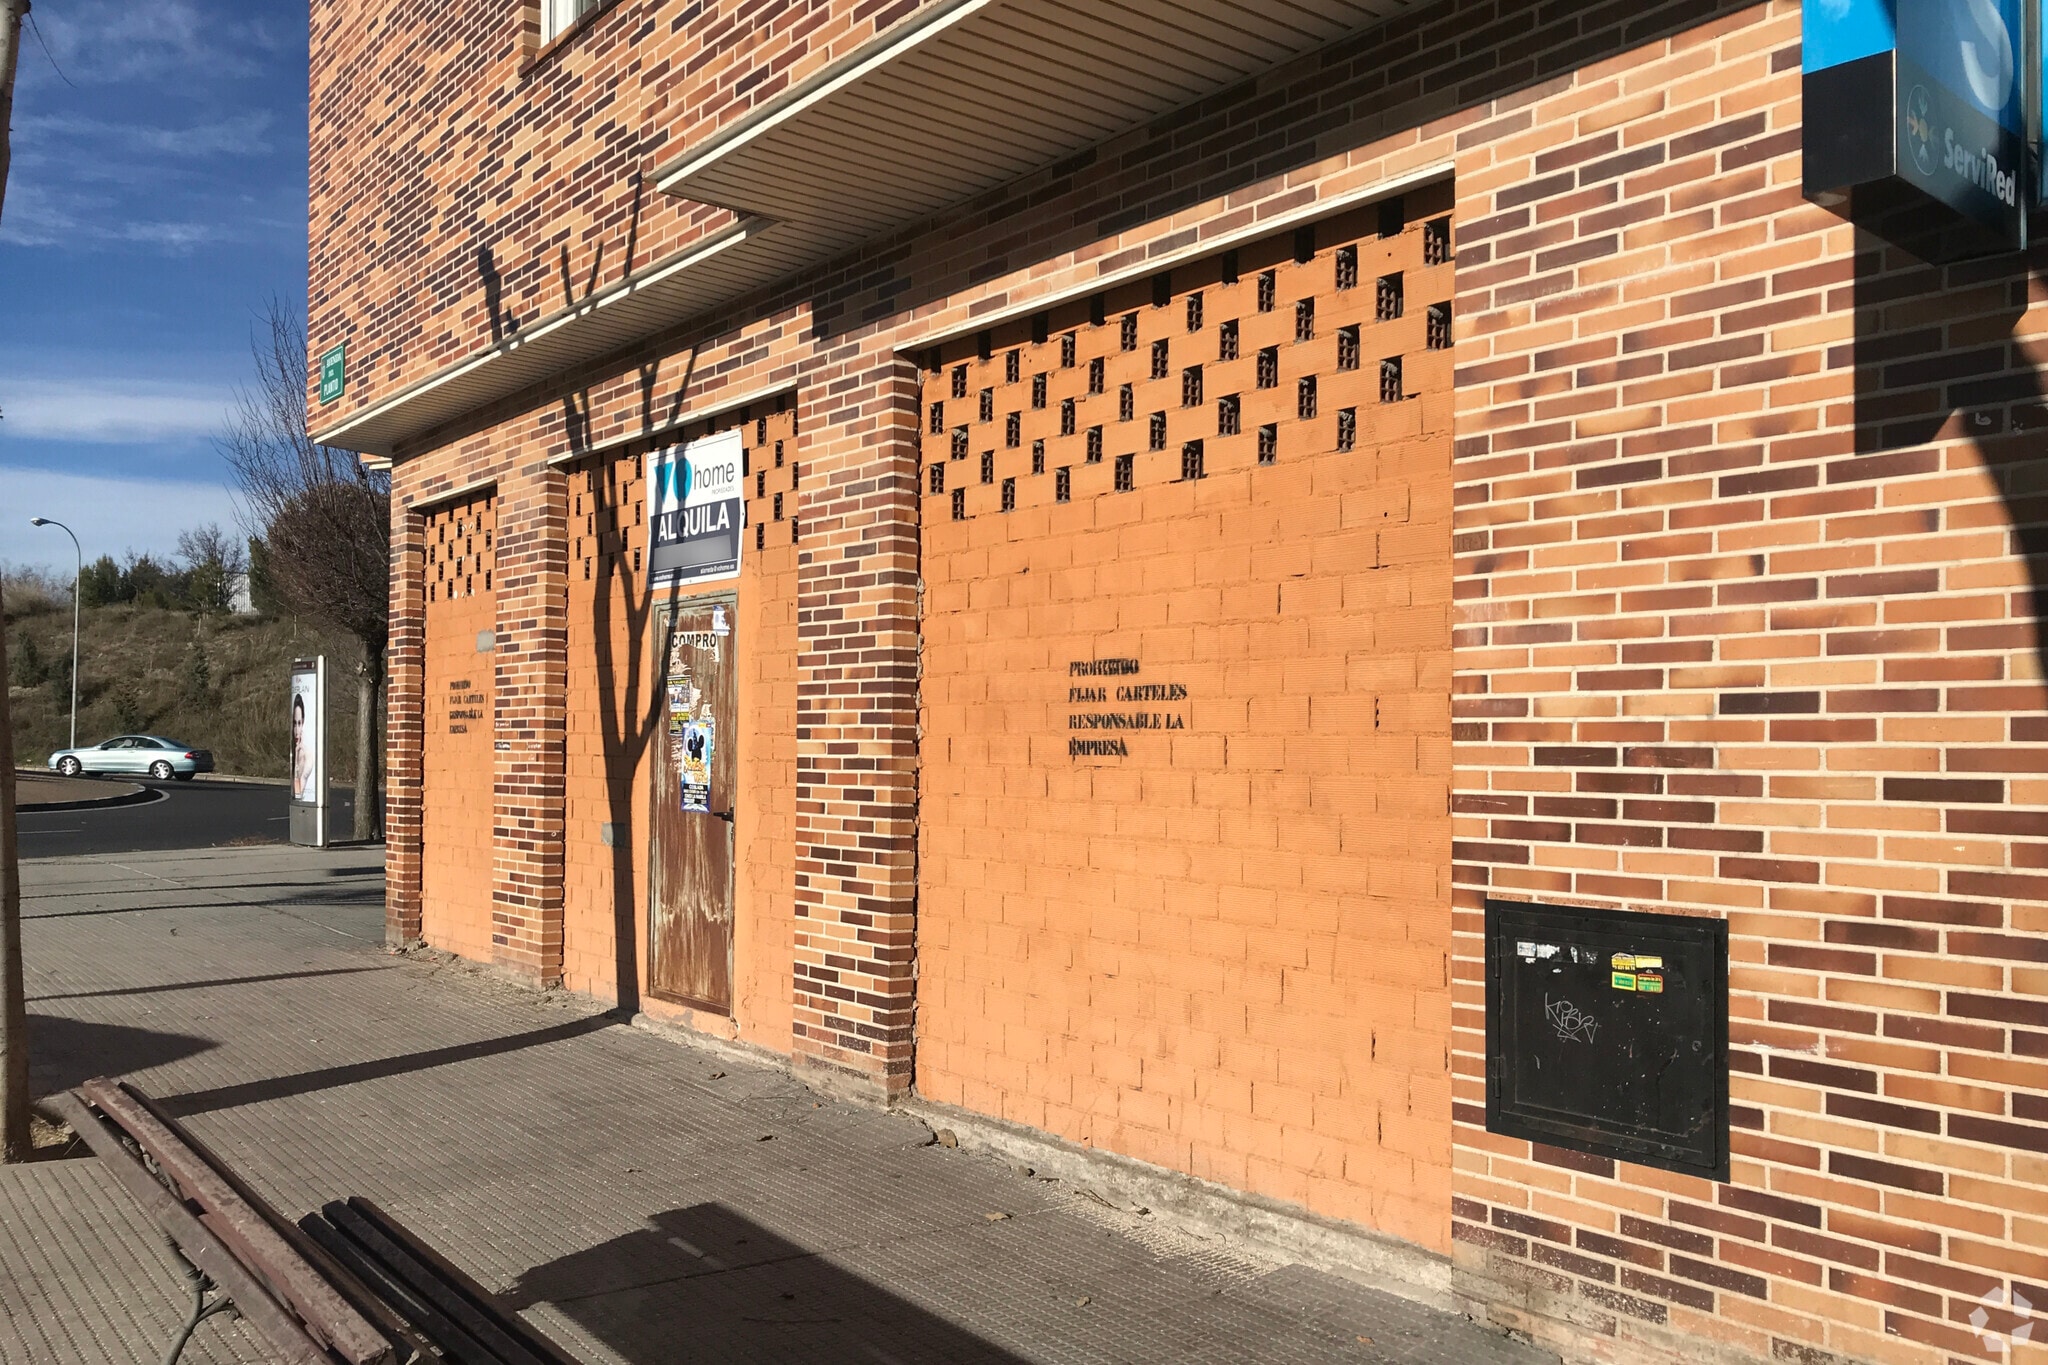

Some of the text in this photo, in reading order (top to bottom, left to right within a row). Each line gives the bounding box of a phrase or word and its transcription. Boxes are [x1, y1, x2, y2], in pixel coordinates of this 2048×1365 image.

[1943, 127, 2016, 207] ServiRed
[693, 462, 735, 490] home
[658, 502, 731, 542] ALQUILA
[671, 633, 717, 648] COMPRO
[1068, 684, 1188, 703] FIJAR CARTELES
[1068, 712, 1185, 730] RESPONSABLE LA
[1068, 738, 1128, 756] EMPRESA
